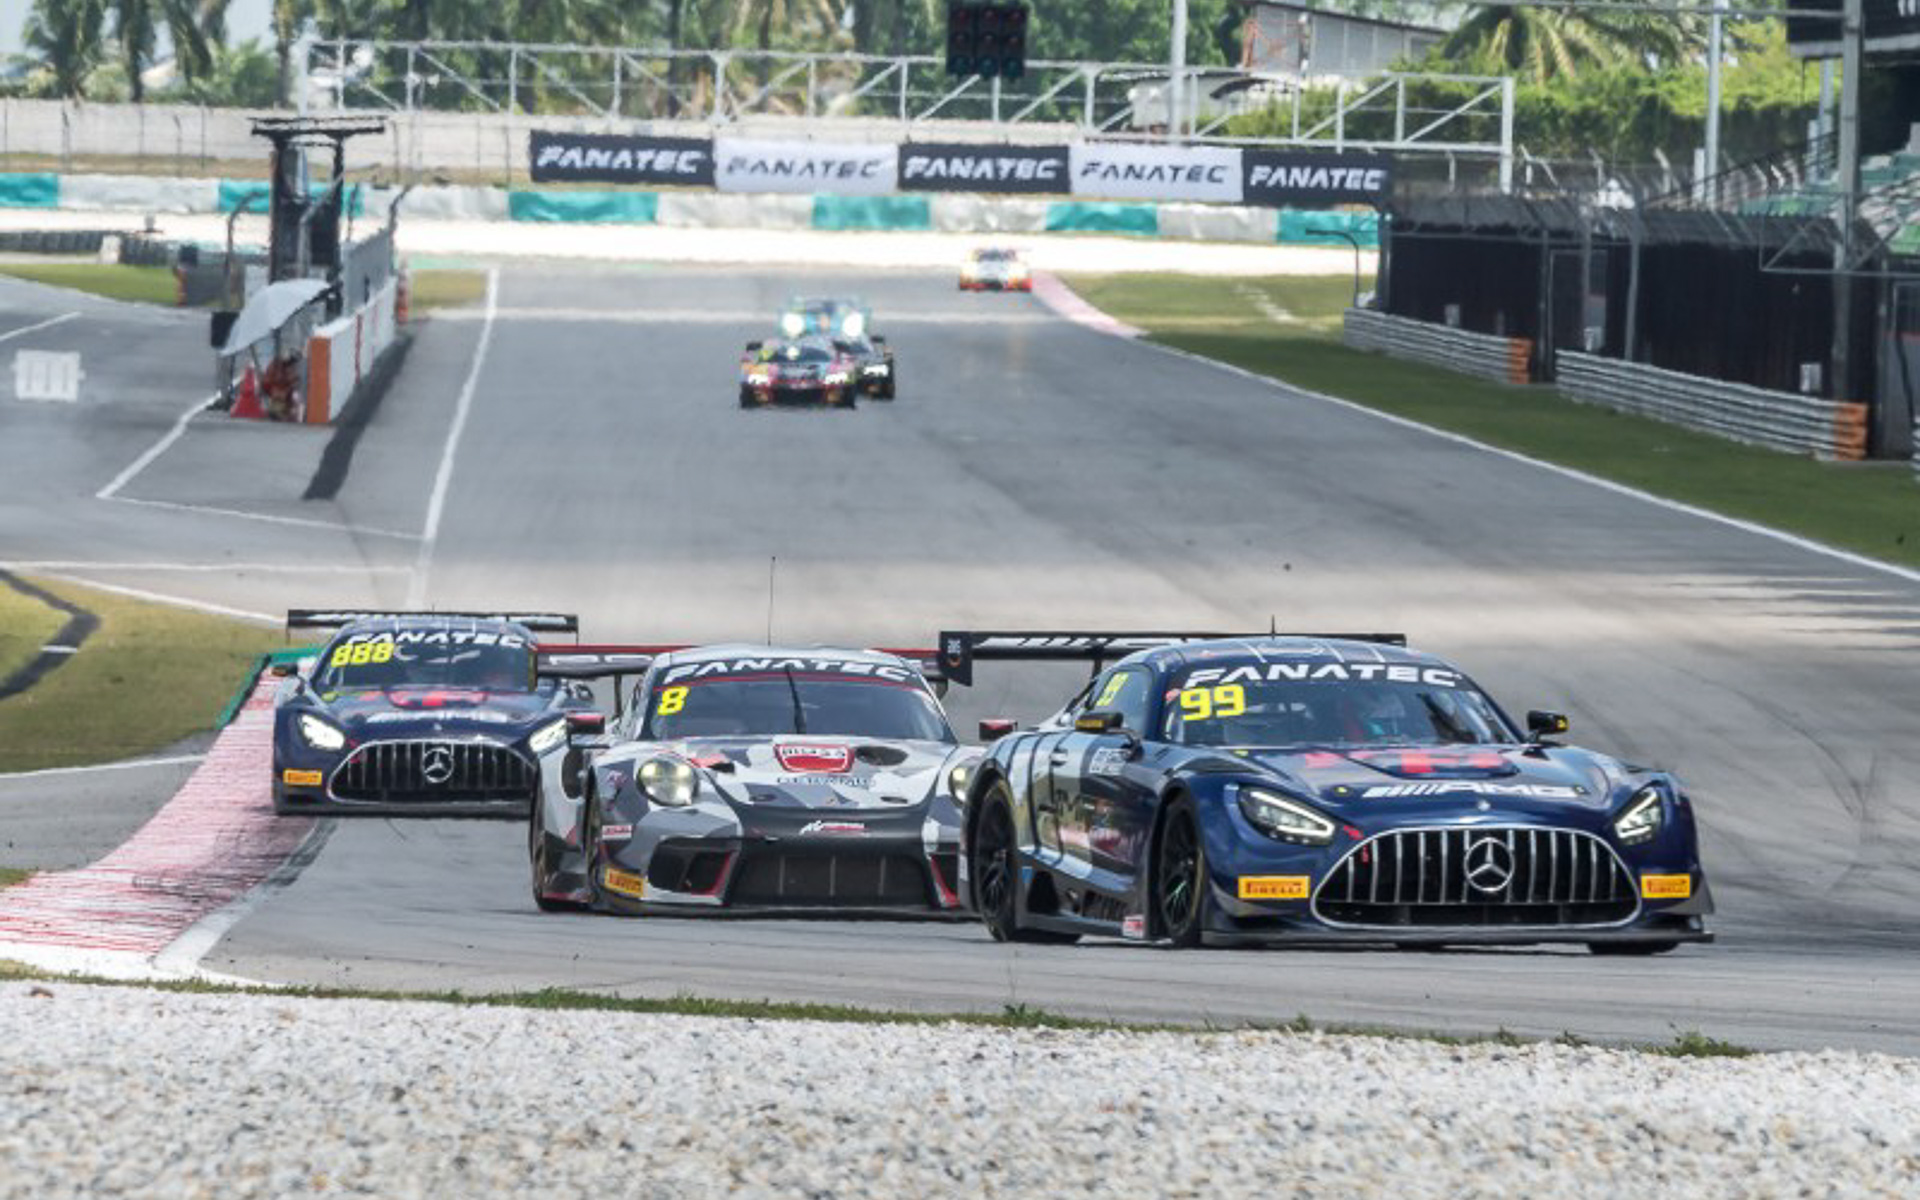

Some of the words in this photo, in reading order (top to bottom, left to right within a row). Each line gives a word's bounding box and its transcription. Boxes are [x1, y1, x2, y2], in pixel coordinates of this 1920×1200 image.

[535, 146, 705, 174] FANATEC
[726, 156, 882, 179] FANATEC
[904, 155, 1063, 181] FANATEC
[1080, 161, 1229, 184] FANATEC
[1250, 164, 1388, 191] FANATEC
[346, 632, 526, 649] FANATEC
[331, 642, 395, 668] 888
[663, 658, 912, 685] FANATEC
[1184, 663, 1458, 689] FANATEC
[657, 685, 690, 716] 8
[1180, 683, 1246, 721] 99
[1245, 881, 1303, 895] PIRELLI
